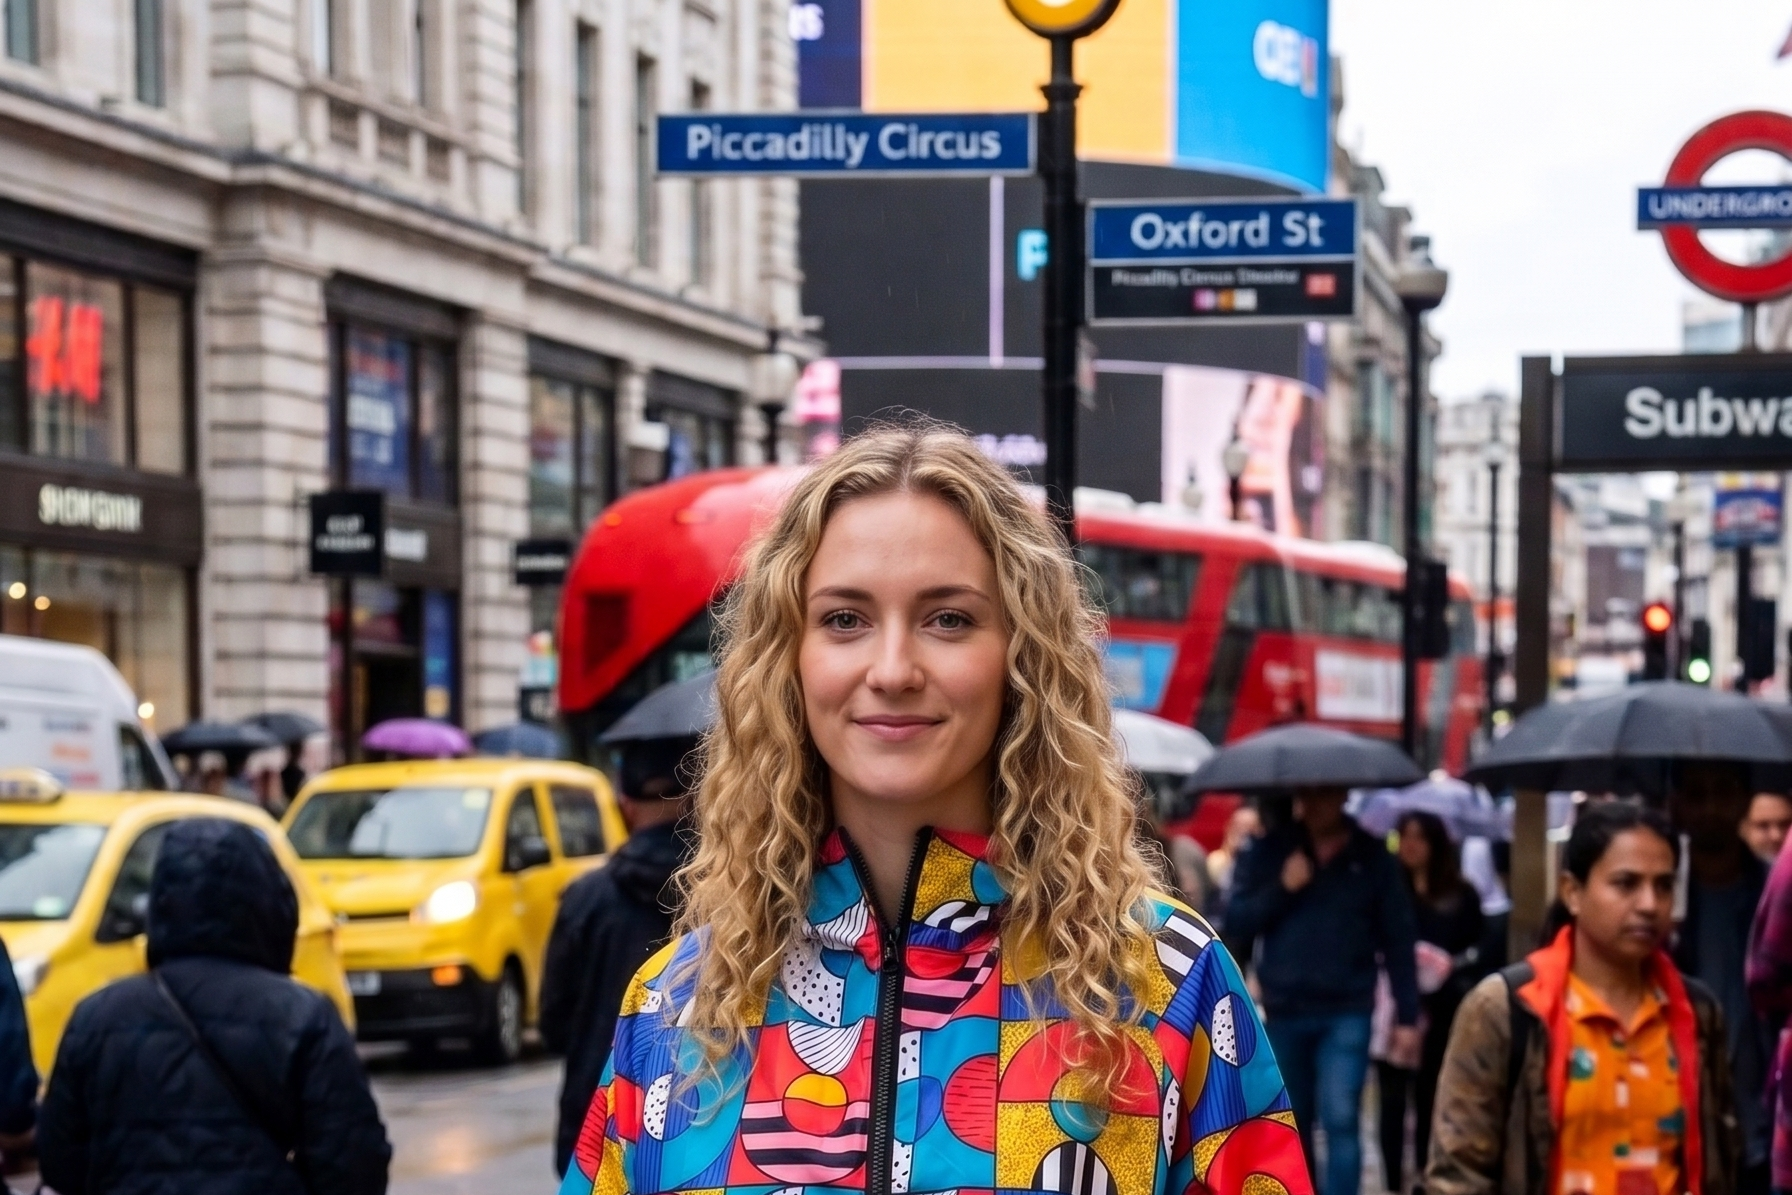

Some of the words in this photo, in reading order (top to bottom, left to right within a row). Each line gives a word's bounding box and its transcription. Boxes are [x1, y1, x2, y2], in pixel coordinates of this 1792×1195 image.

[686, 122, 869, 169] Piccadilly
[878, 122, 1002, 161] Circus
[1130, 210, 1270, 250] Oxford
[1282, 210, 1326, 247] St
